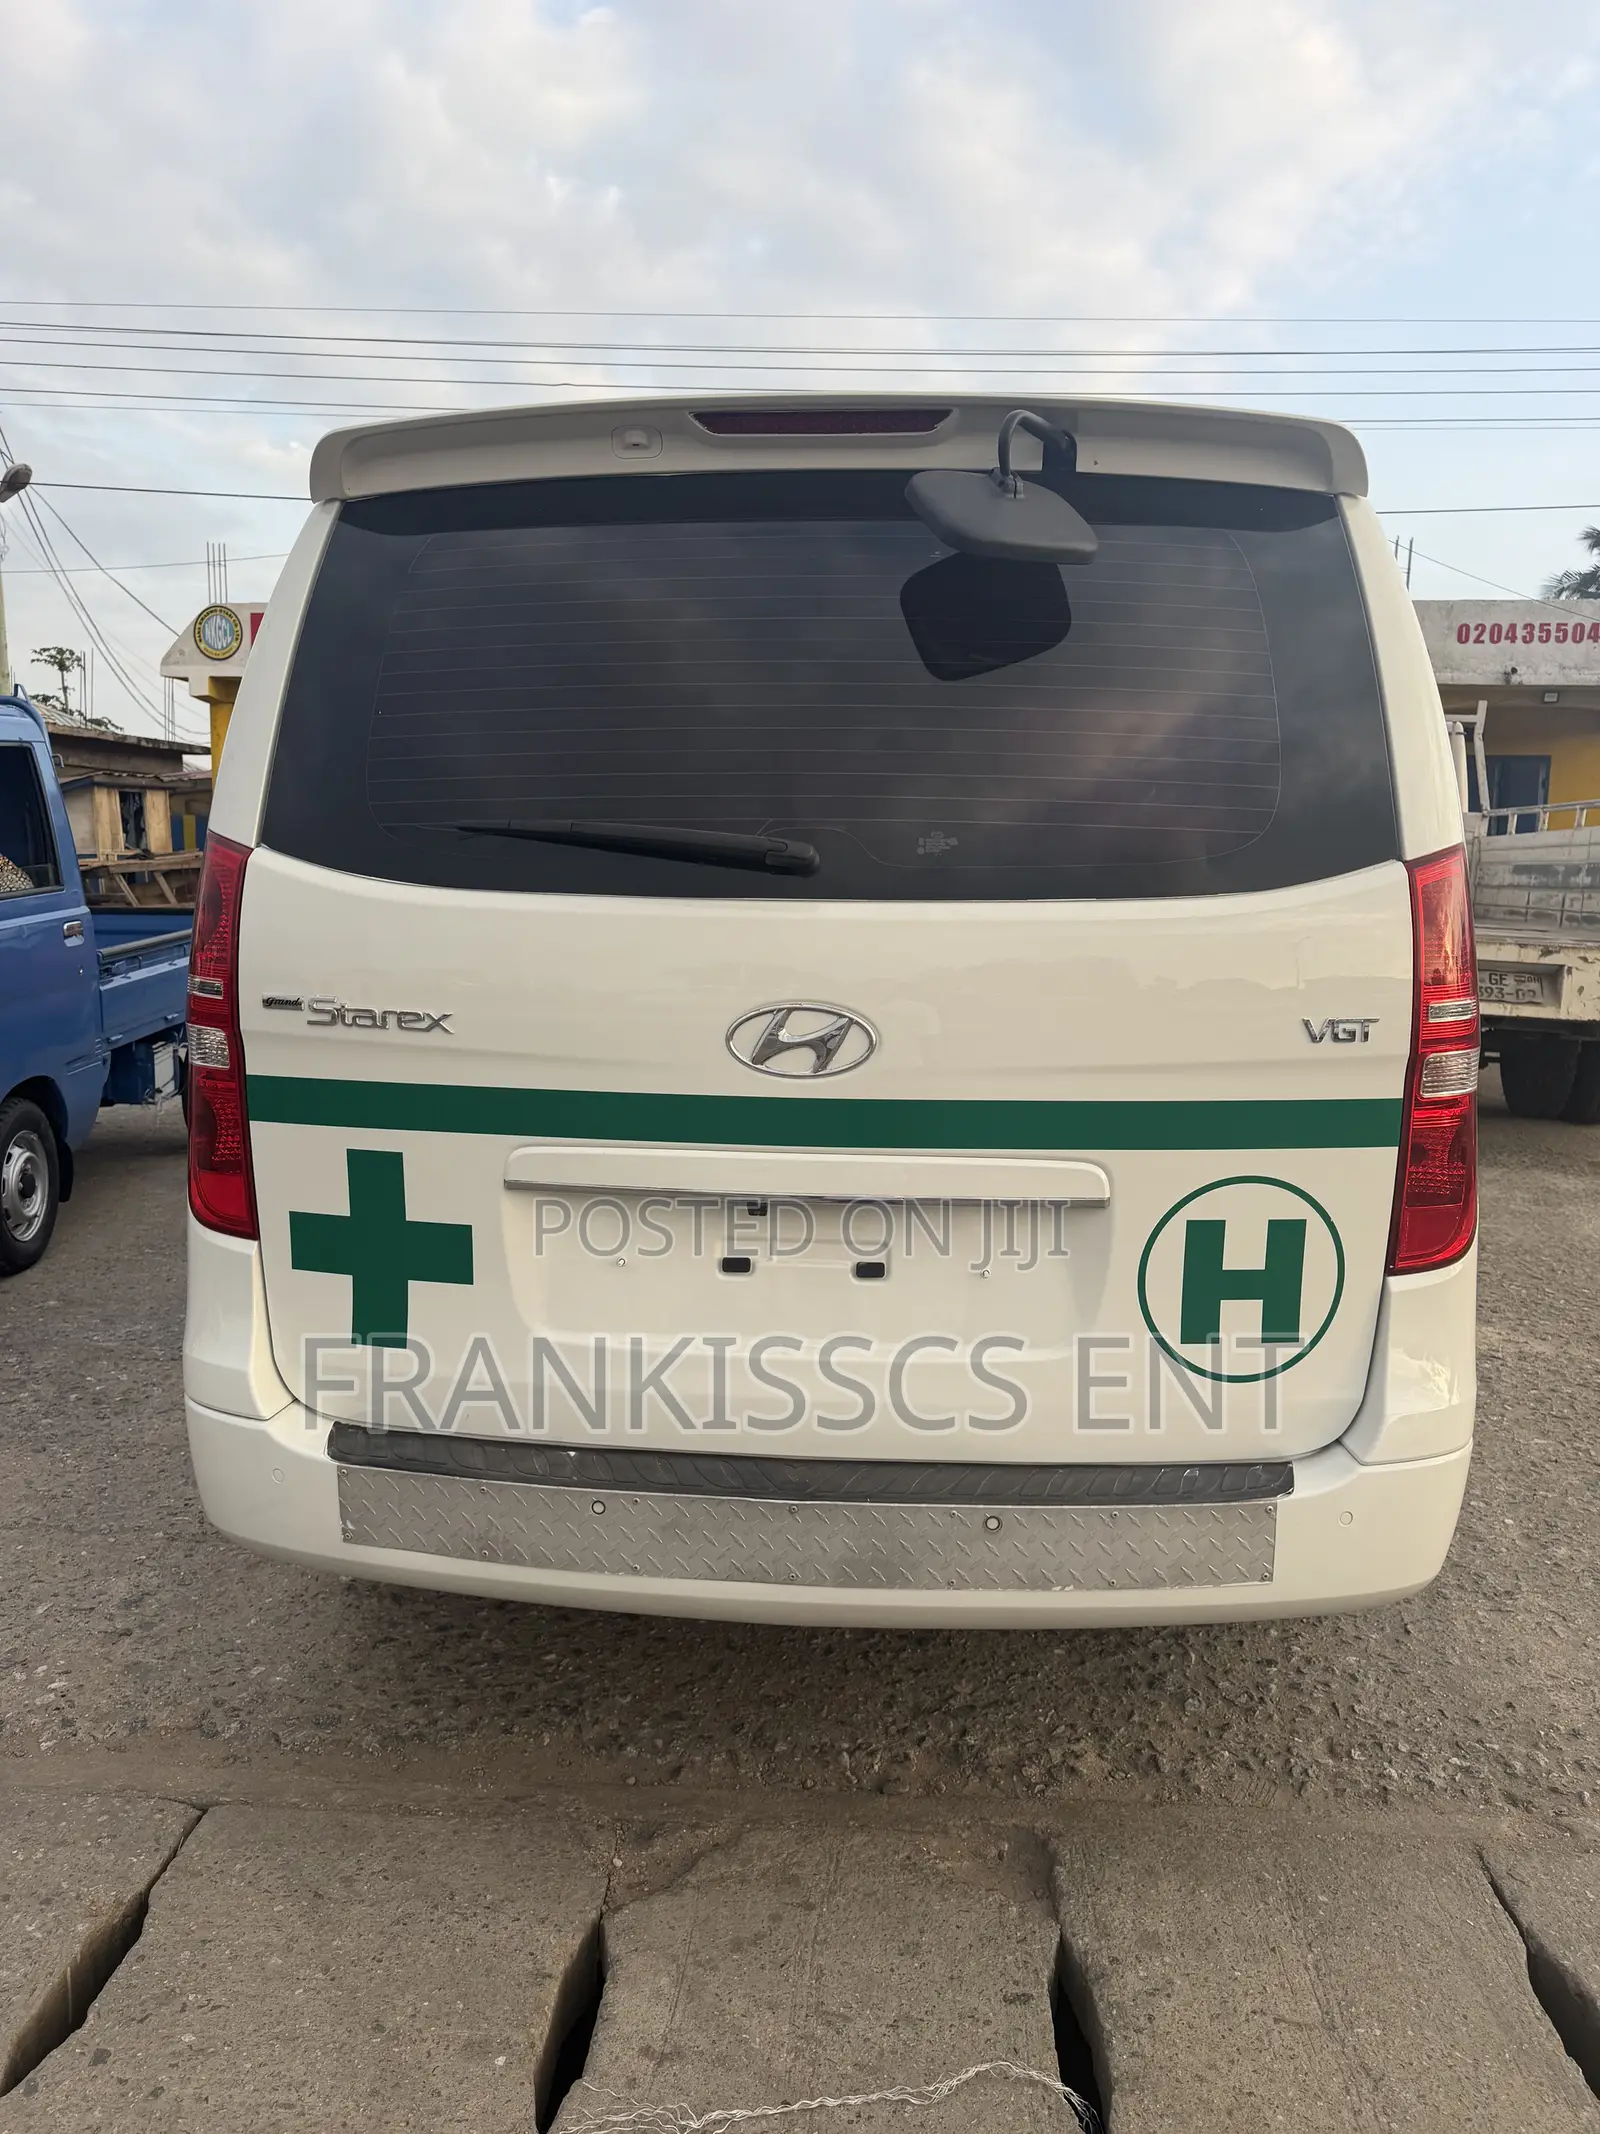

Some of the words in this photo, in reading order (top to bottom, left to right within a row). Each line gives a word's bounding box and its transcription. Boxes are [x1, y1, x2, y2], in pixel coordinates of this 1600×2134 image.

[1457, 622, 1600, 644] 020435504
[1488, 972, 1508, 986] GE
[307, 994, 454, 1034] Starex
[1302, 1017, 1380, 1043] VGT
[1180, 1218, 1307, 1345] H
